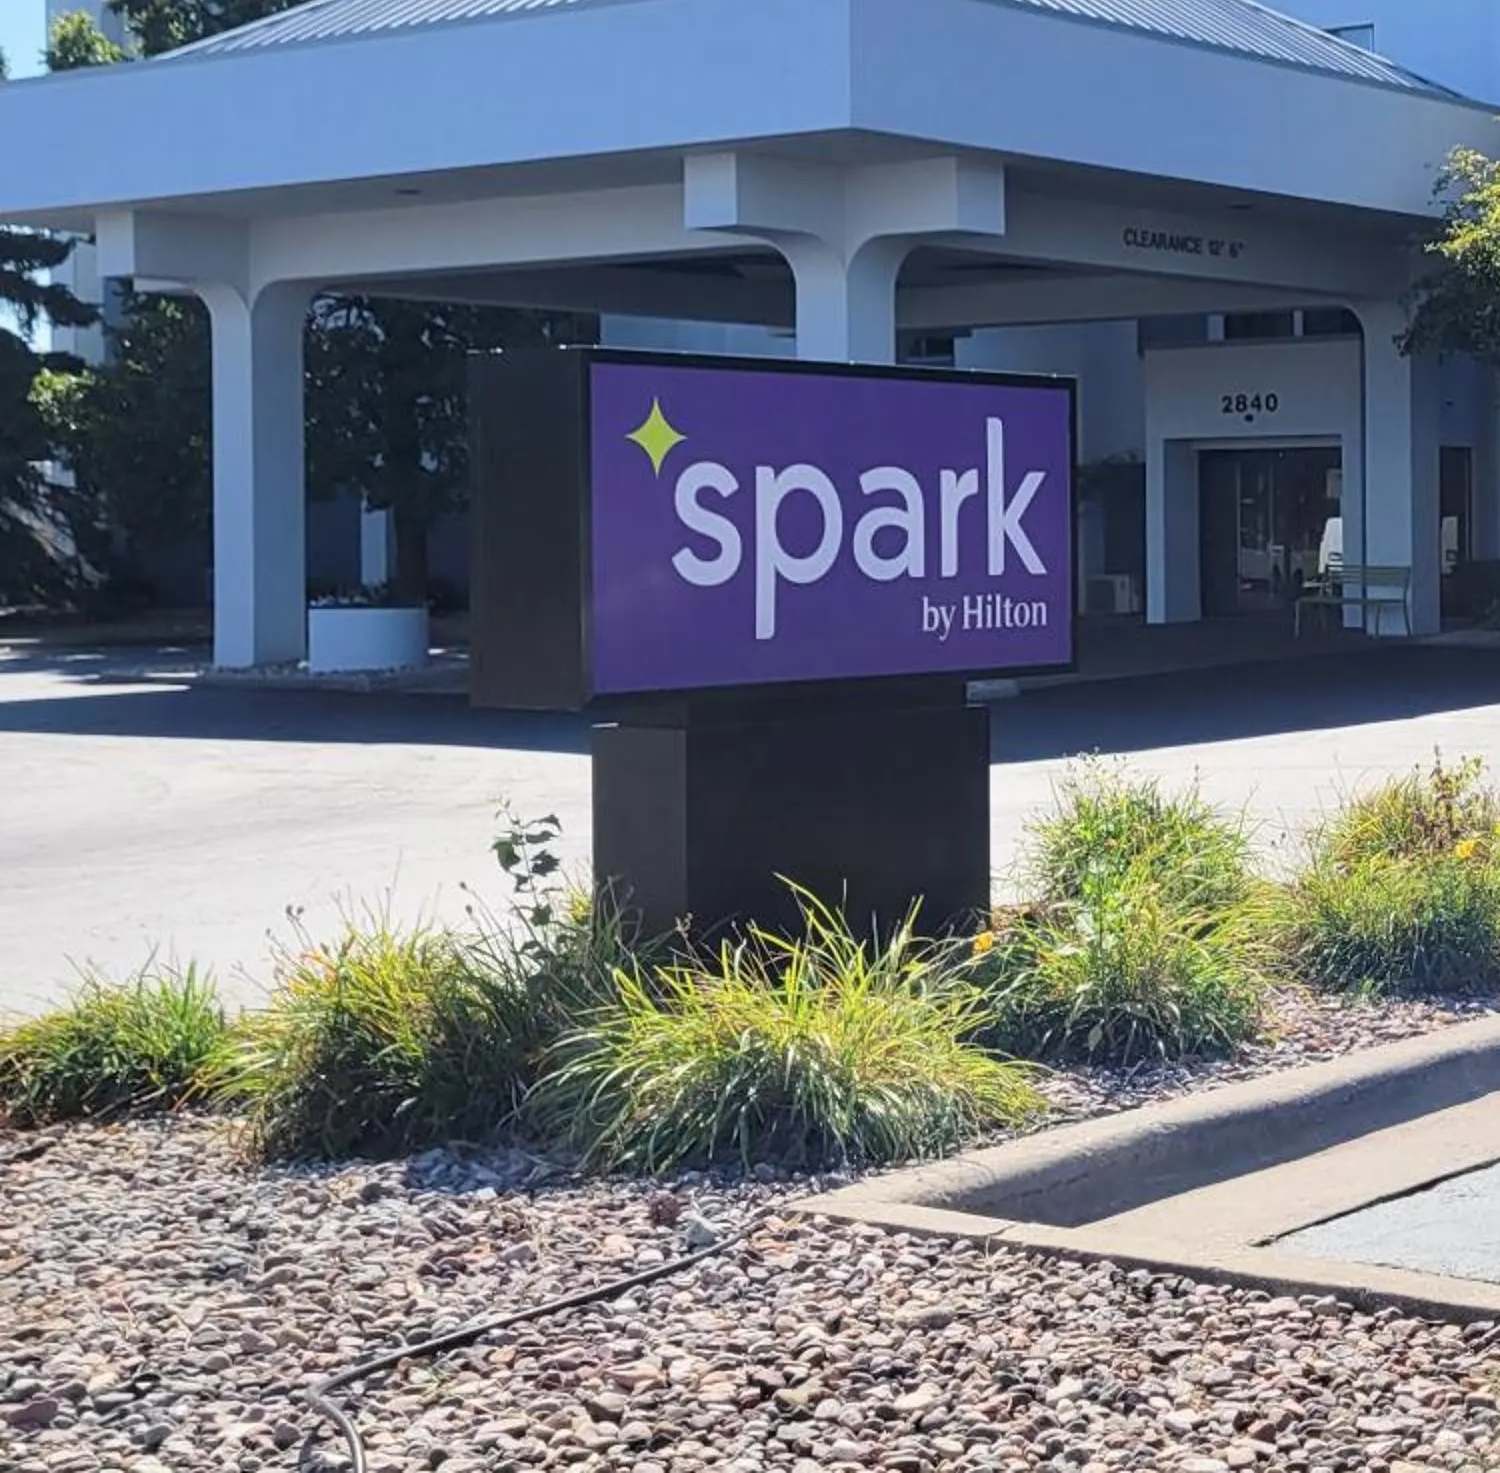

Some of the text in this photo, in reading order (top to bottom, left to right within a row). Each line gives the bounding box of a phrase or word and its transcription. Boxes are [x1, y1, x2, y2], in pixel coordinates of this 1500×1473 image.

[1123, 227, 1202, 255] CLEARANCE
[1222, 393, 1278, 414] 2840
[672, 416, 1048, 639] spark
[922, 593, 1048, 641] by Hilton
